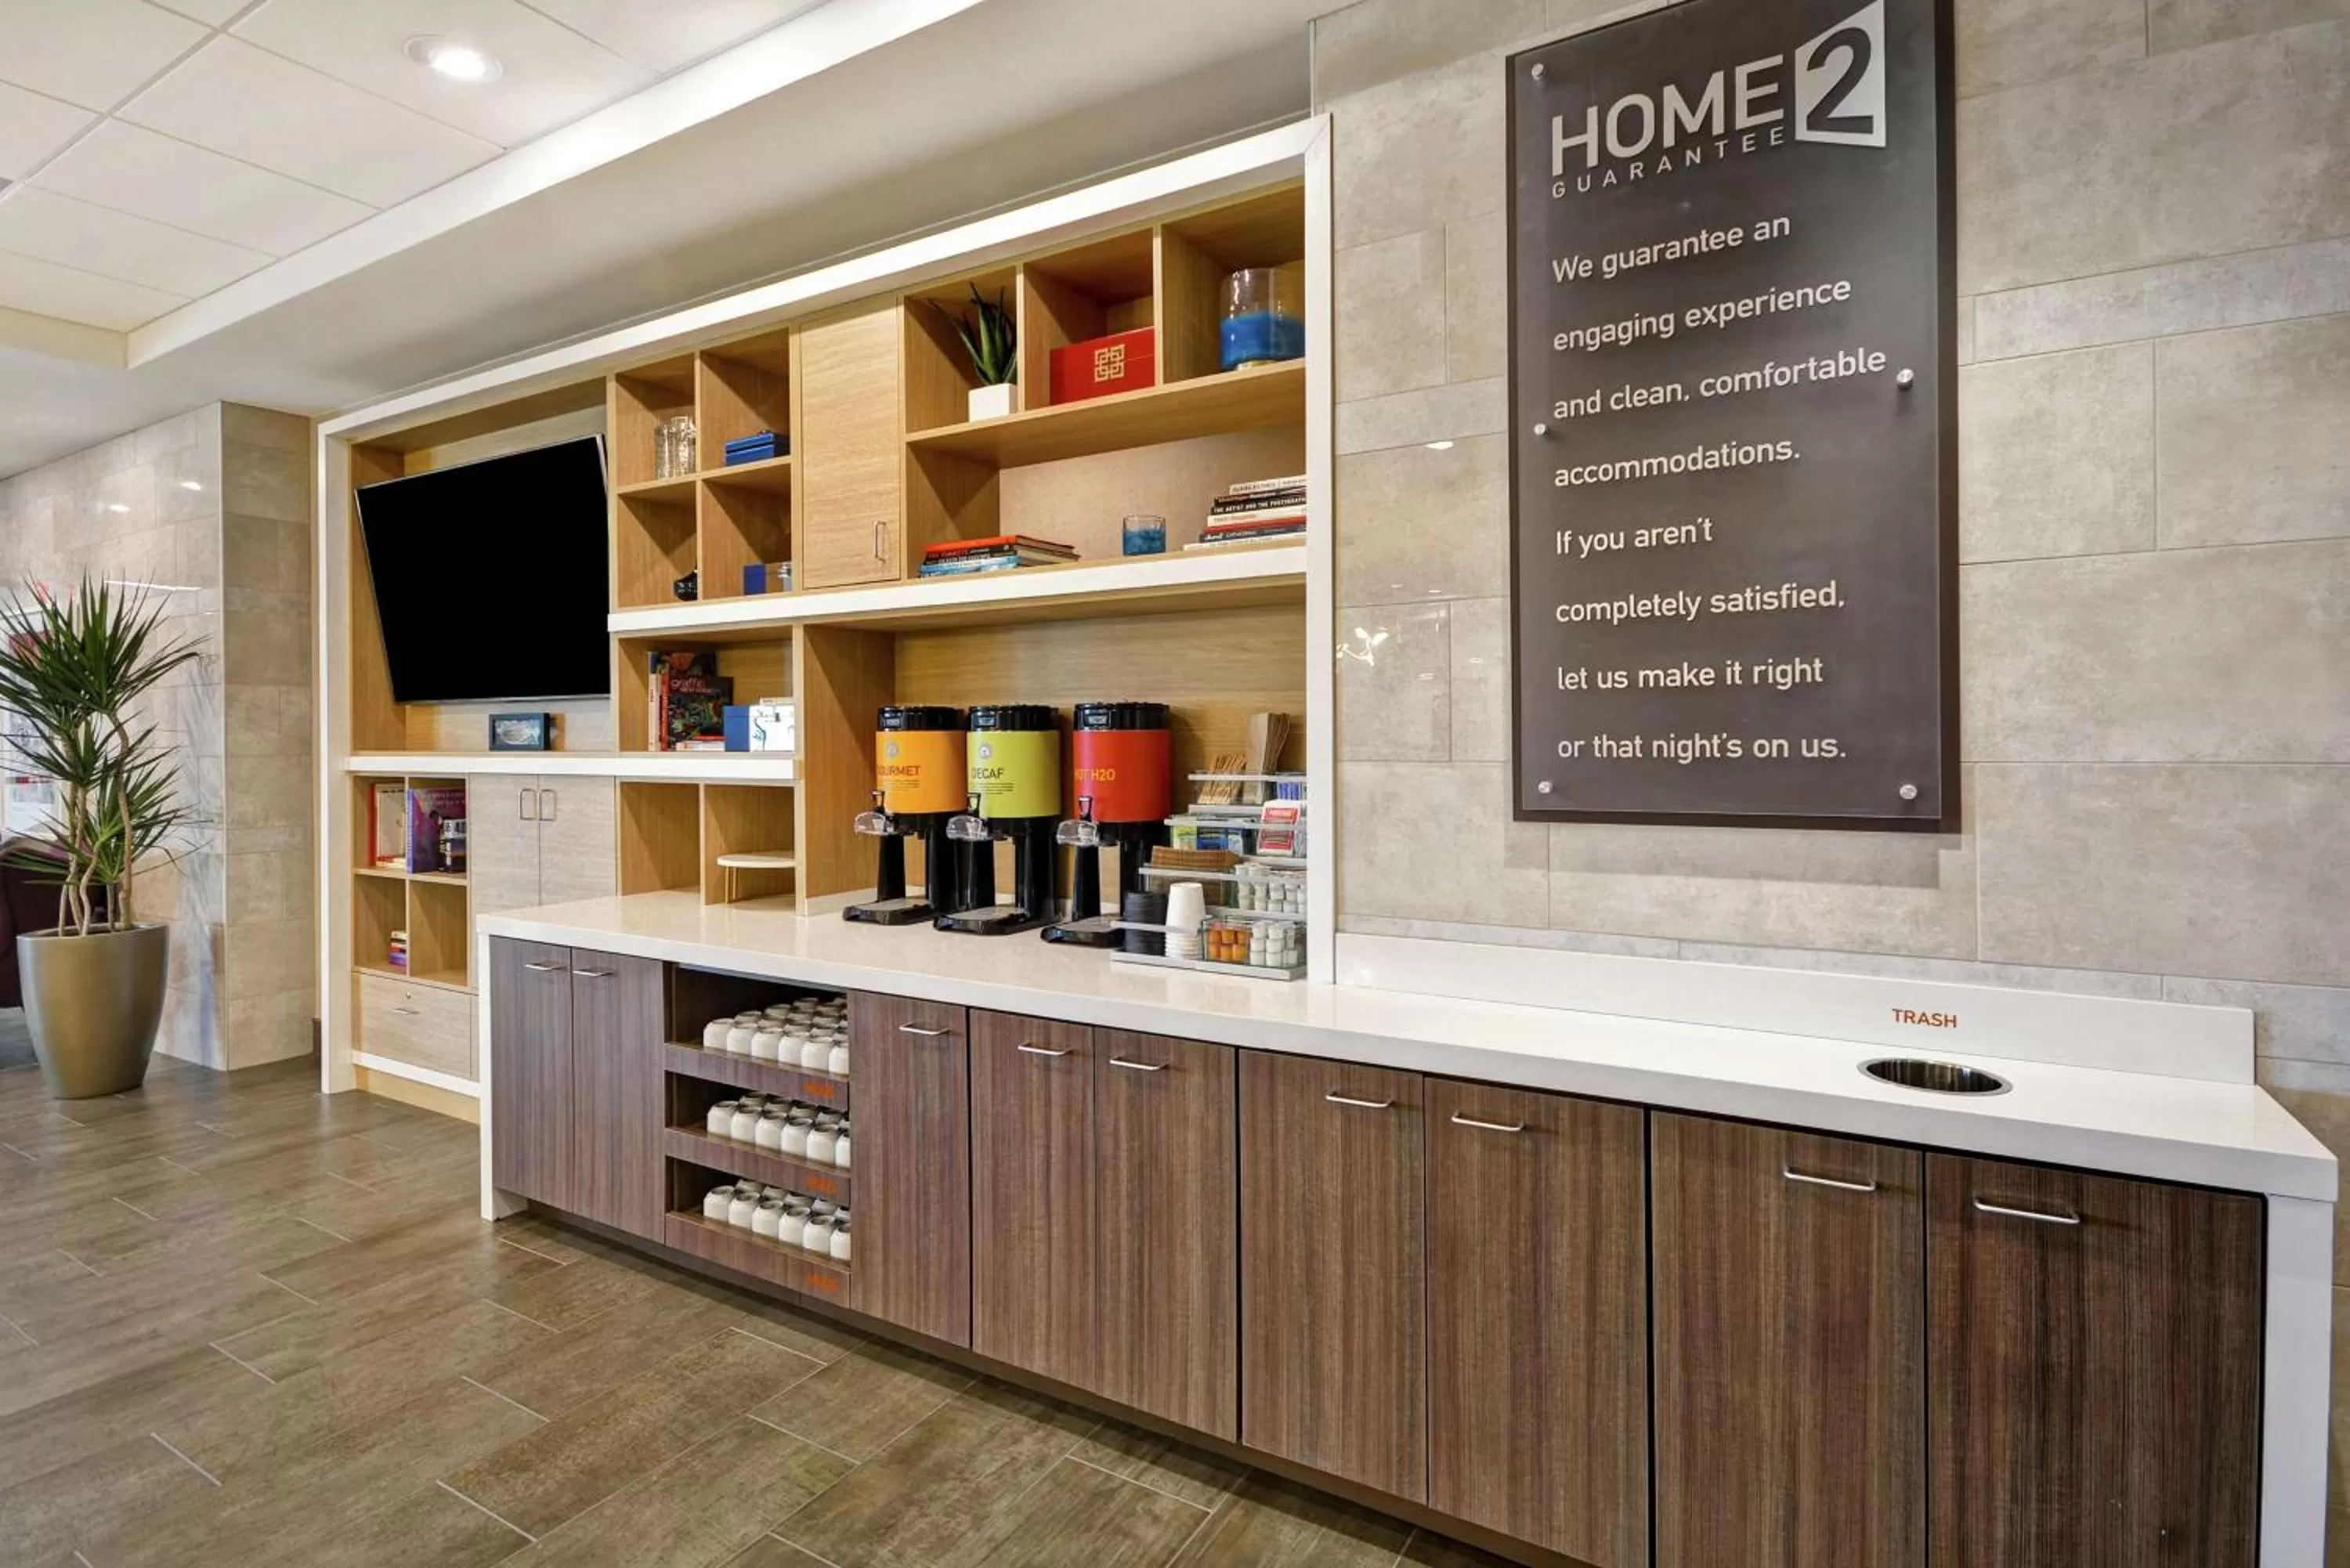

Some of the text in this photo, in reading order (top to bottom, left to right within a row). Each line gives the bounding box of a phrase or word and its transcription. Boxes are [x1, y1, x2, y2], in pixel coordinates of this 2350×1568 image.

[1552, 26, 1875, 177] HOME 2
[1552, 126, 1784, 198] GUARANTEE
[1552, 217, 1790, 283] We guarantee an
[1553, 280, 1851, 352] engaging experience
[1553, 389, 1600, 419] and
[1700, 347, 1886, 397] comfortable
[1554, 441, 1800, 486] accommodations.
[1556, 517, 1712, 558] If you aren't
[1556, 591, 1702, 625] completely
[1558, 657, 1823, 690] let us make it right
[1558, 732, 1846, 764] or that night's on us.
[971, 767, 1005, 780] DECAF
[1091, 768, 1115, 781] H2O
[1892, 1008, 1958, 1028] TRASH
